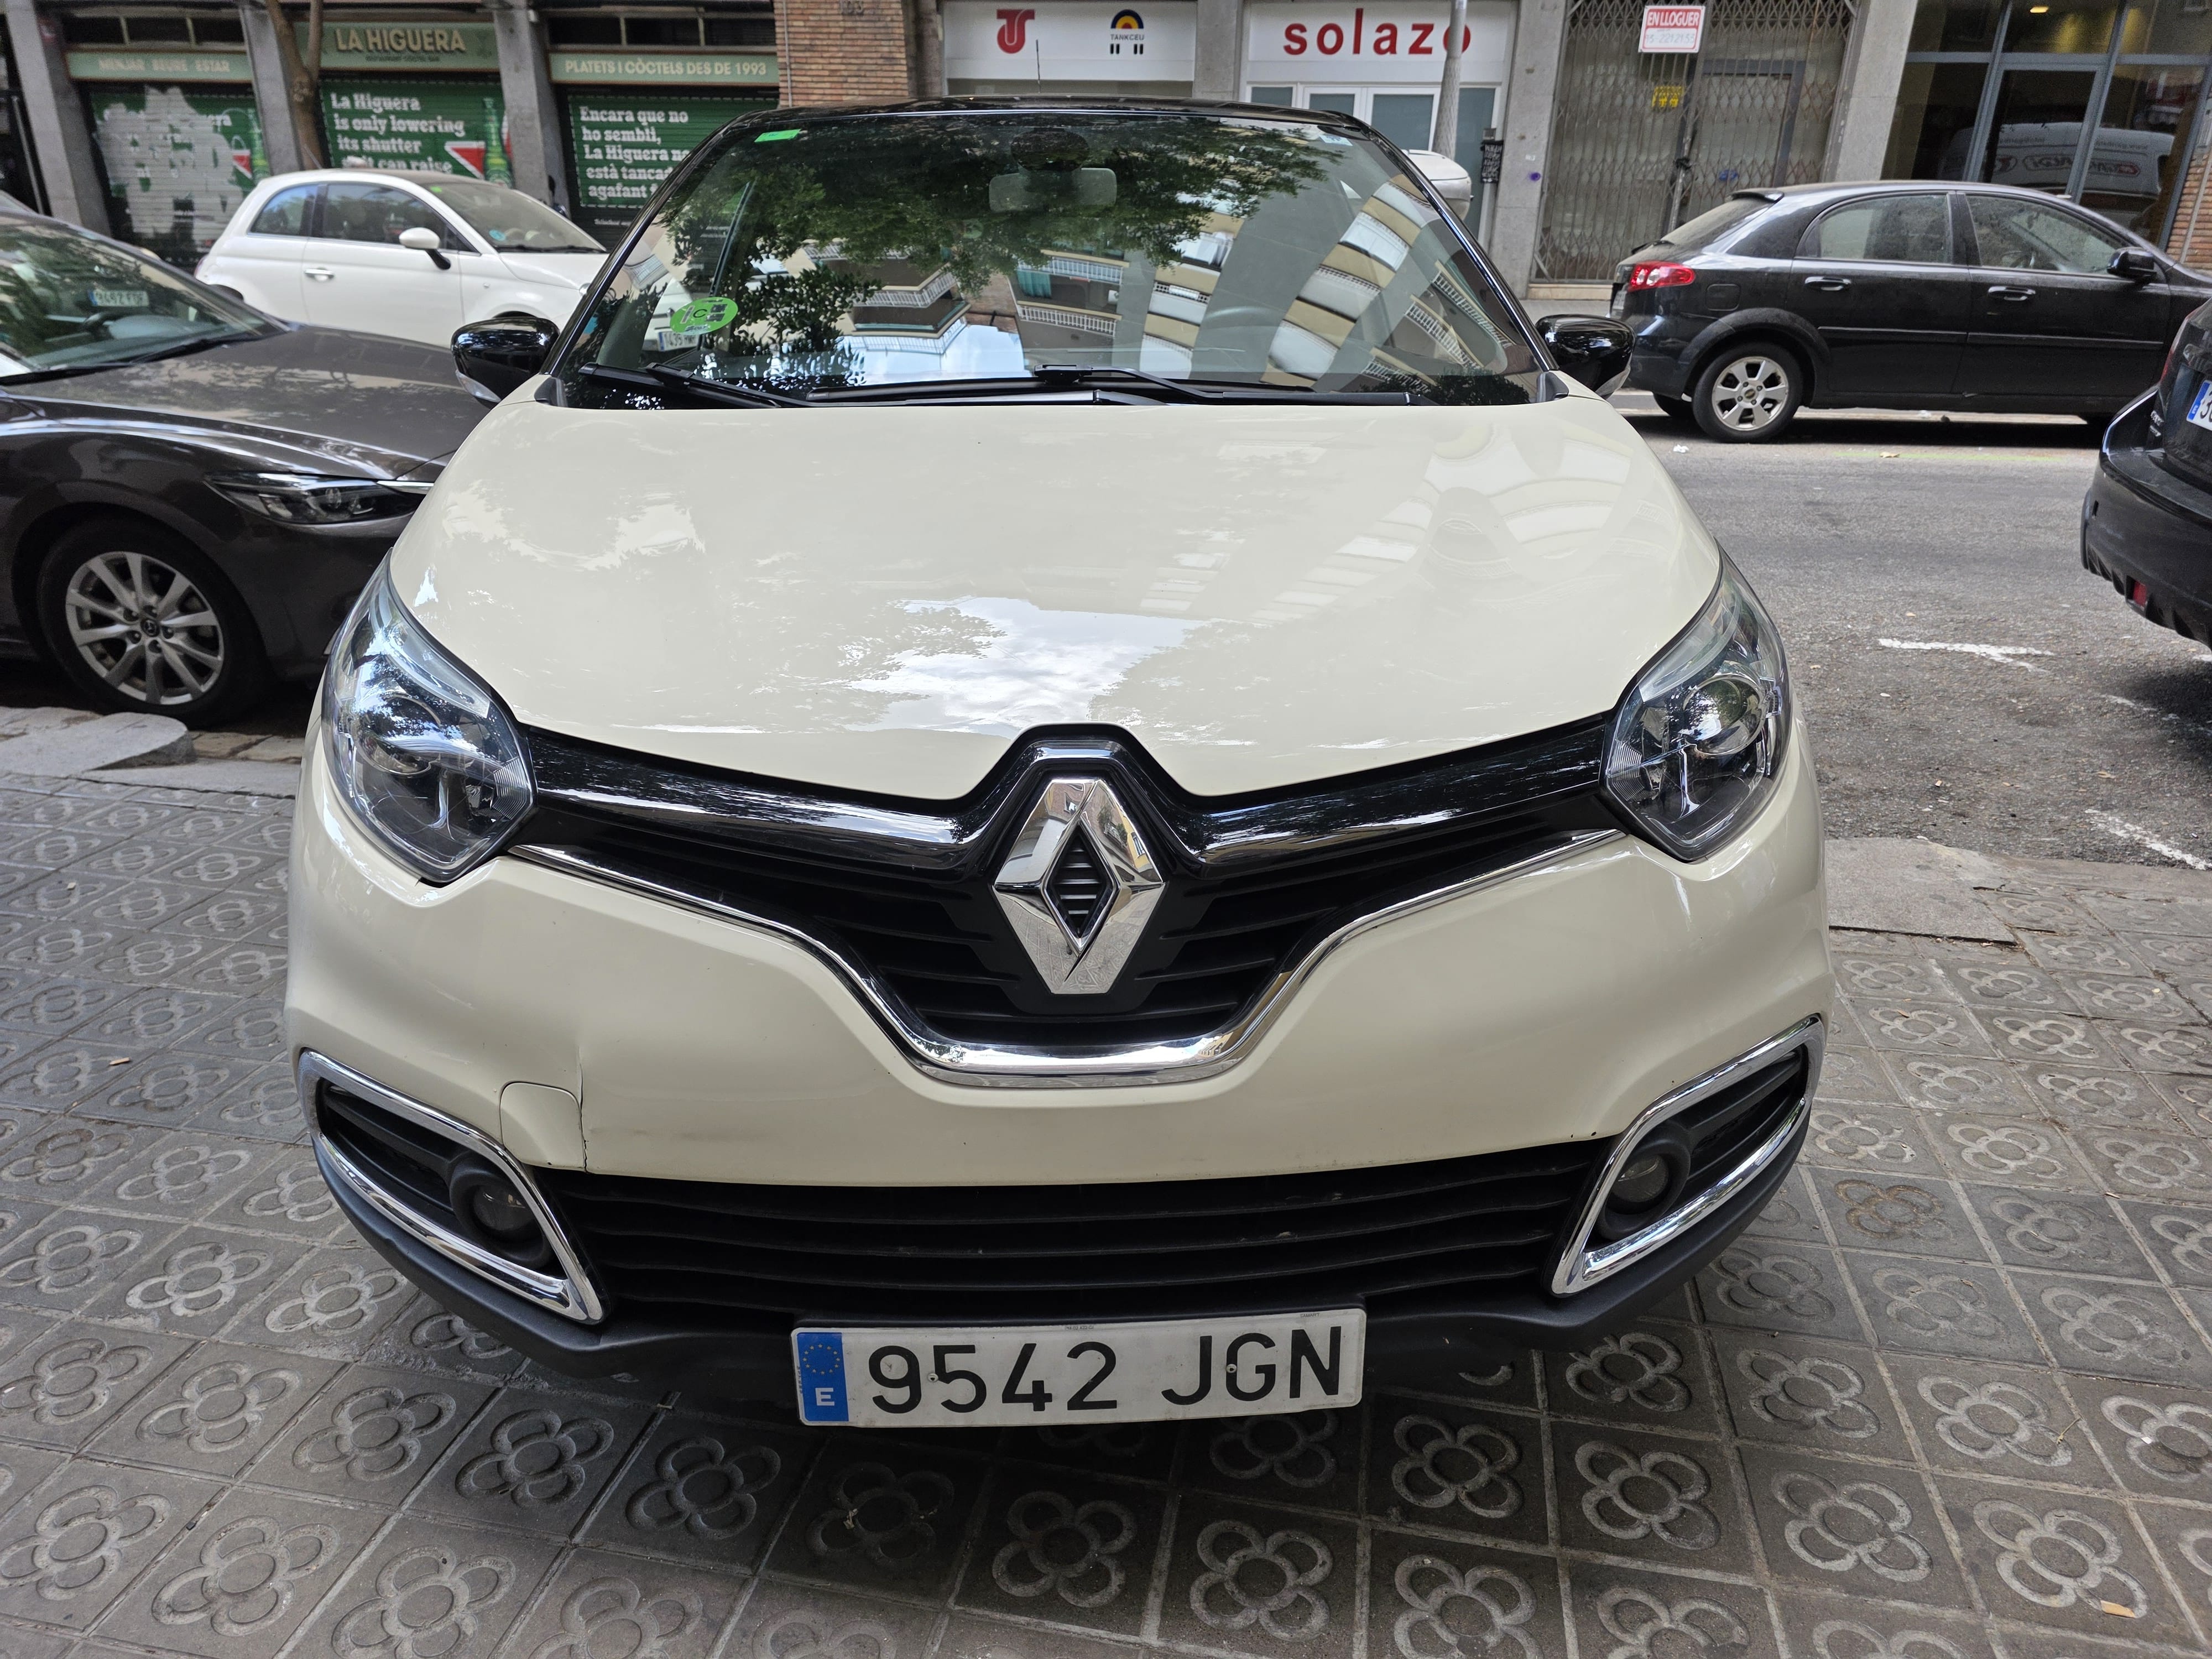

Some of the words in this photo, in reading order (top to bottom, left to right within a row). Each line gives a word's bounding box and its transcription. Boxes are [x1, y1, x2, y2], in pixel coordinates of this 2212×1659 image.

[1646, 12, 1659, 26] EN
[1660, 12, 1699, 26] LLOGUER
[335, 28, 363, 51] LA
[364, 29, 466, 52] HIGUERA
[565, 60, 615, 74] PLATETS
[625, 59, 684, 75] CÒCTELS
[687, 63, 711, 75] DES
[714, 63, 731, 75] DE
[736, 62, 766, 75] 1993
[331, 92, 351, 109] La
[353, 93, 421, 113] Higuera
[333, 113, 349, 130] is
[352, 114, 387, 135] only
[389, 114, 466, 137] lowering
[580, 106, 635, 122] Encara
[637, 111, 665, 126] que
[668, 111, 689, 122] no
[337, 134, 359, 150] its
[362, 136, 422, 153] shutter
[582, 126, 601, 141] ho
[604, 127, 662, 145] sembli,
[583, 144, 603, 159] La
[604, 145, 669, 164] Higuera
[378, 159, 407, 170] can
[409, 155, 453, 174] raise
[586, 164, 619, 179] està
[588, 183, 648, 201] agafant
[693, 309, 707, 318] C
[815, 1387, 834, 1406] E
[868, 1343, 1118, 1414] 9542
[1161, 1326, 1343, 1406] JGN
